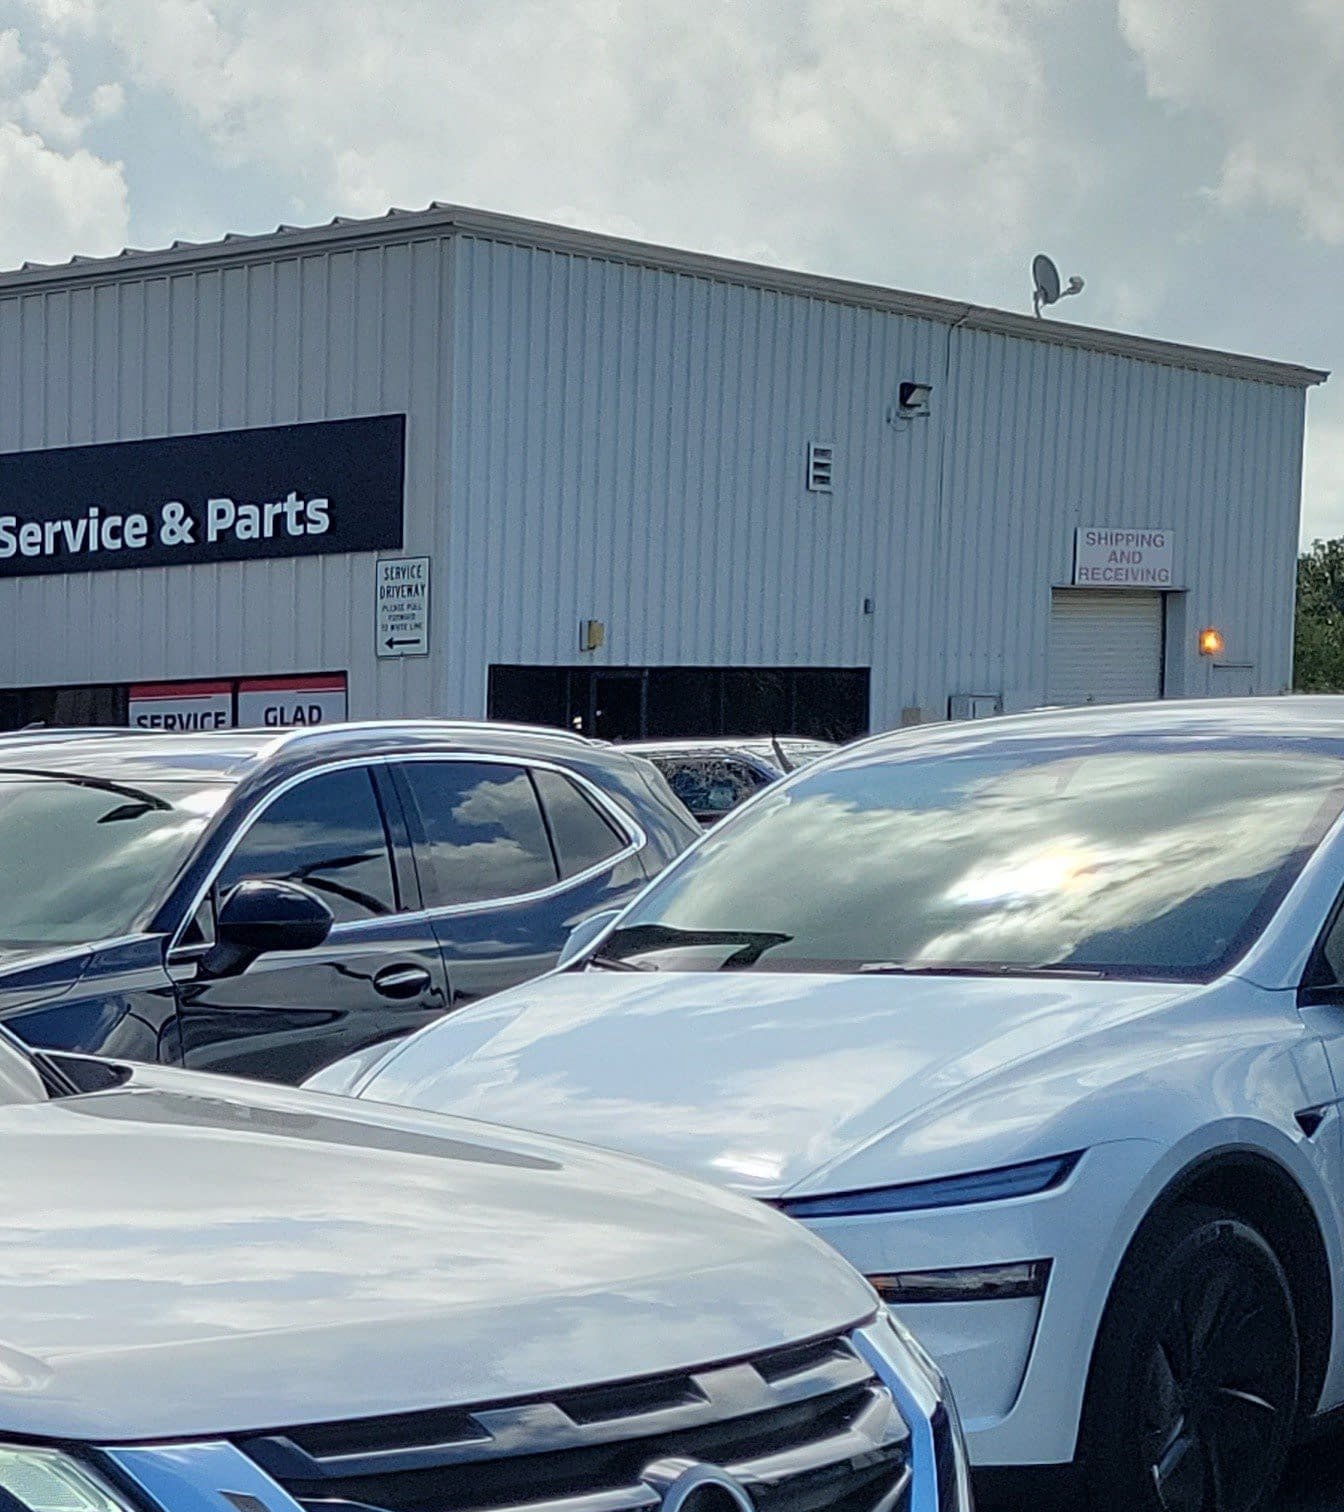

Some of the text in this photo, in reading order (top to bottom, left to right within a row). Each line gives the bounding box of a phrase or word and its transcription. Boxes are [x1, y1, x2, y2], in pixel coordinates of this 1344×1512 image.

[160, 502, 196, 546] &
[207, 491, 330, 542] Parts
[1085, 531, 1165, 548] SHIPPING
[1107, 550, 1143, 564] AND
[384, 564, 422, 581] SERVICE
[1078, 566, 1170, 583] RECEIVING
[379, 583, 426, 600] DRIVEWAY
[136, 711, 227, 731] SERVICE
[264, 704, 323, 727] GLAD
